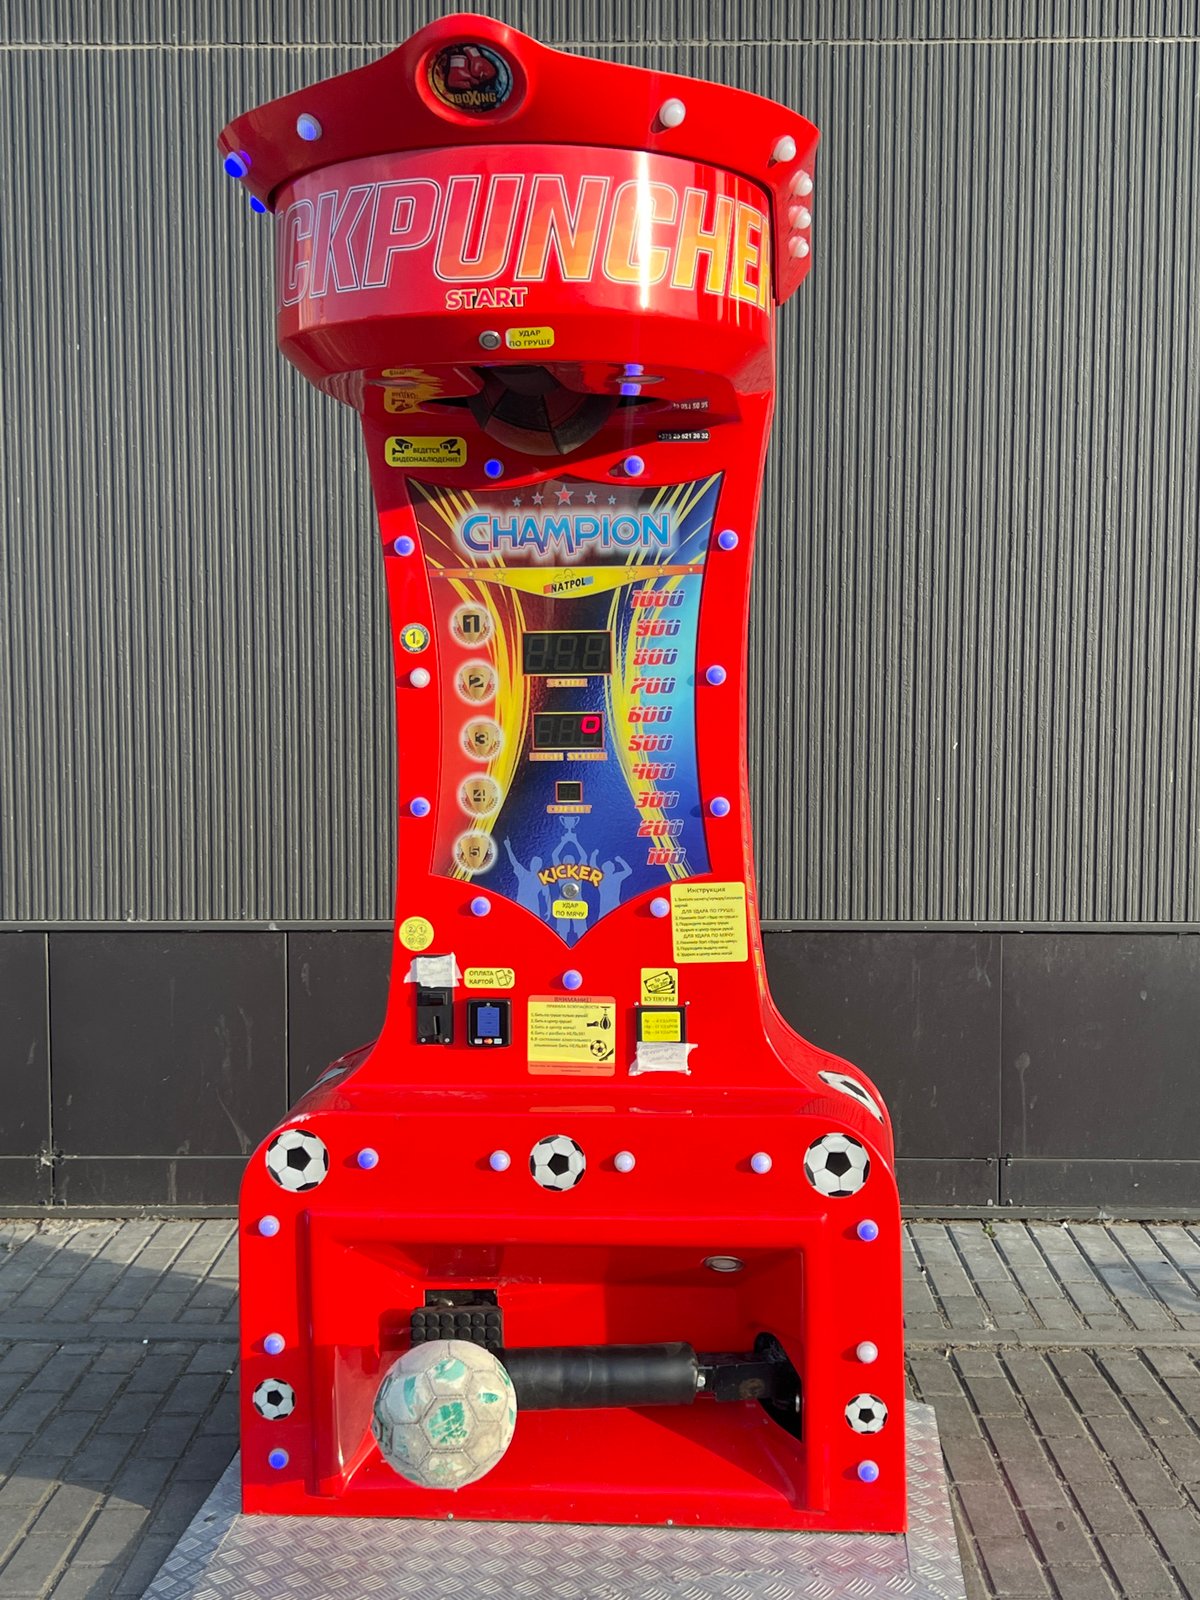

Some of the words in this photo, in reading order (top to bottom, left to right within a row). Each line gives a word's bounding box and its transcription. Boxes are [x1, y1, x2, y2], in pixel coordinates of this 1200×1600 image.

[453, 90, 498, 106] BOXING
[277, 172, 770, 315] CKPUNCHE
[446, 287, 527, 310] START
[517, 328, 541, 338] УДАР
[508, 338, 522, 348] ПО
[524, 337, 552, 348] ГРУШЕ
[461, 512, 671, 557] CHAMPION
[550, 577, 586, 593] NATPOL
[632, 589, 685, 608] 1000
[634, 648, 677, 665] 800
[631, 677, 675, 694] 700
[628, 706, 672, 723] 600
[628, 734, 672, 751] 500
[632, 763, 675, 779] 400
[636, 791, 679, 808] 300
[637, 818, 683, 836] 200
[647, 847, 686, 864] 100
[538, 864, 603, 886] KICKER
[555, 909, 566, 917] ПО
[566, 910, 585, 918] МЯЧУ
